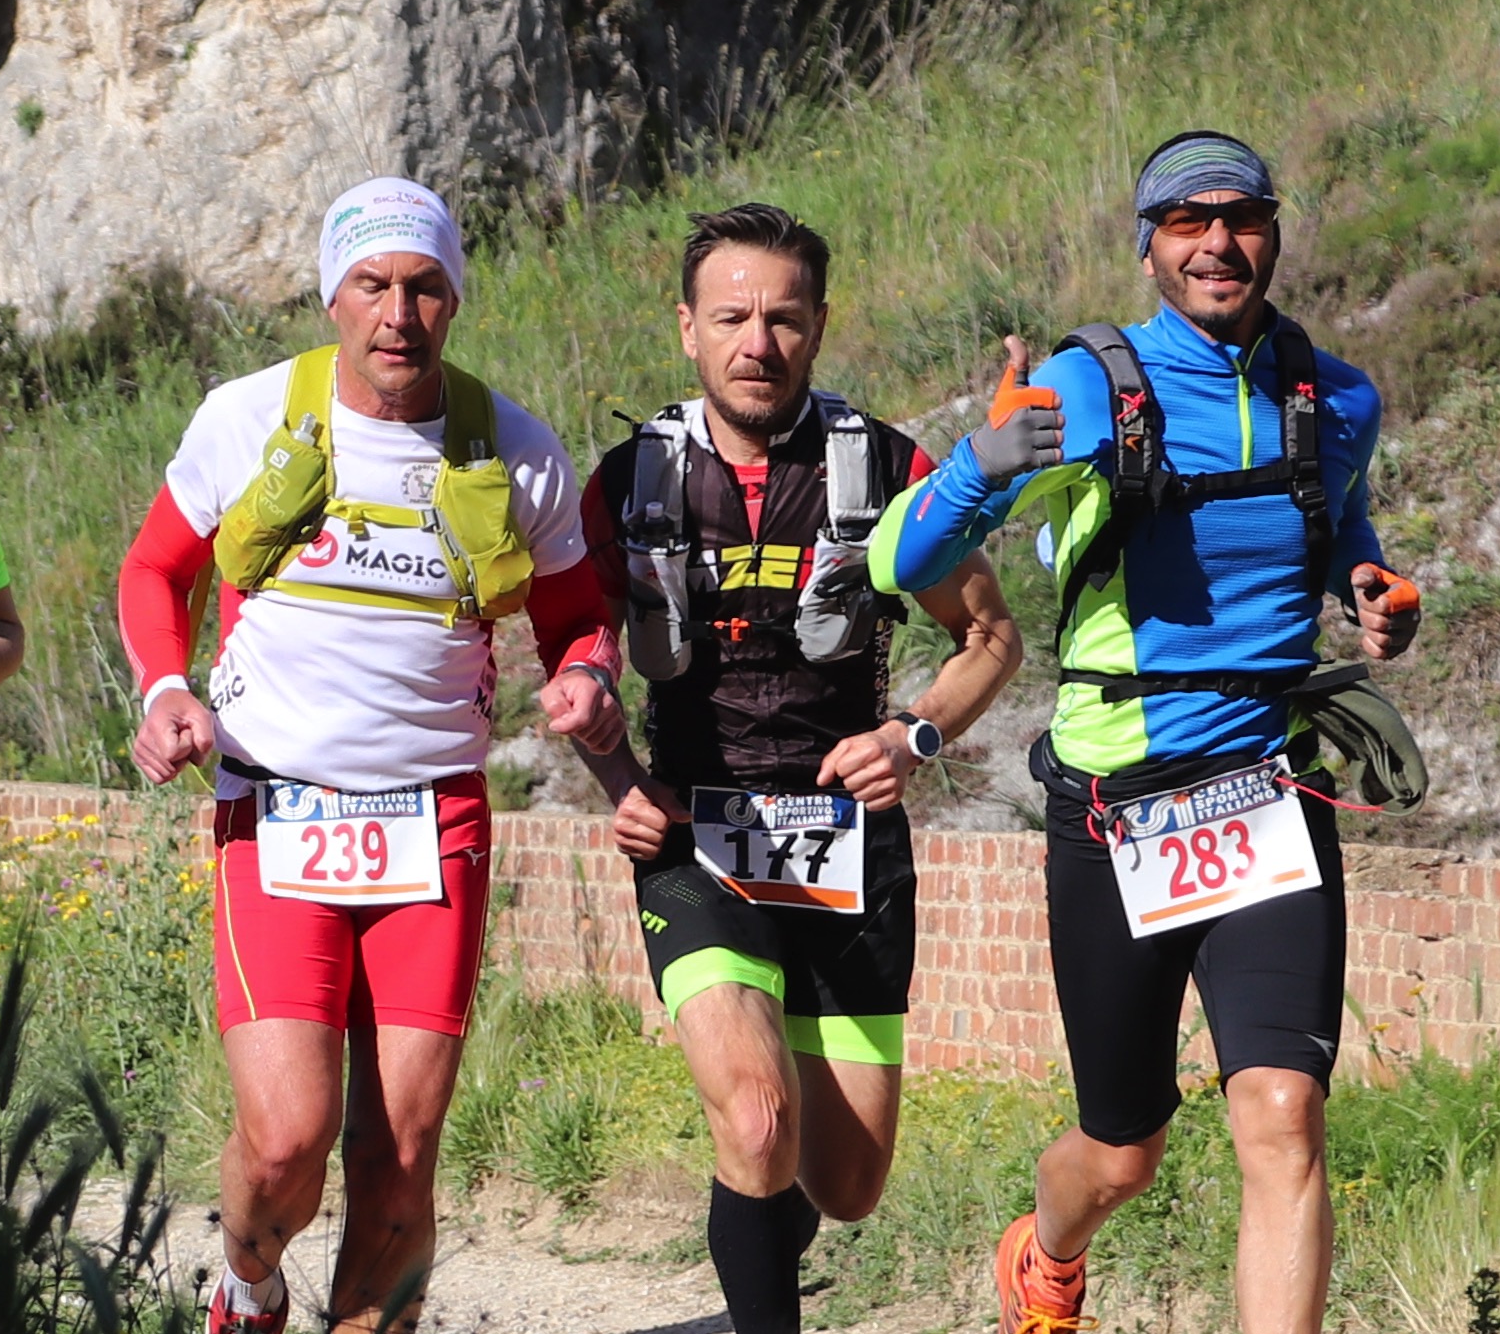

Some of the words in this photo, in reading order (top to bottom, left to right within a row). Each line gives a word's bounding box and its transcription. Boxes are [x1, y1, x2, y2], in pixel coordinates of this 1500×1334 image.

[355, 221, 415, 238] Edizione
[1193, 769, 1272, 800] CENTRO
[1195, 781, 1273, 810] SPORTIVO
[341, 792, 417, 806] SPORTIVO
[342, 803, 418, 815] ITALIANO
[776, 795, 833, 807] CENTRO
[1197, 789, 1277, 820] ITALIANO
[777, 805, 833, 817] SPORTIVO
[777, 815, 833, 826] ITALIANO
[301, 820, 388, 882] 239
[724, 829, 837, 884] 177
[1159, 819, 1256, 899] 283
